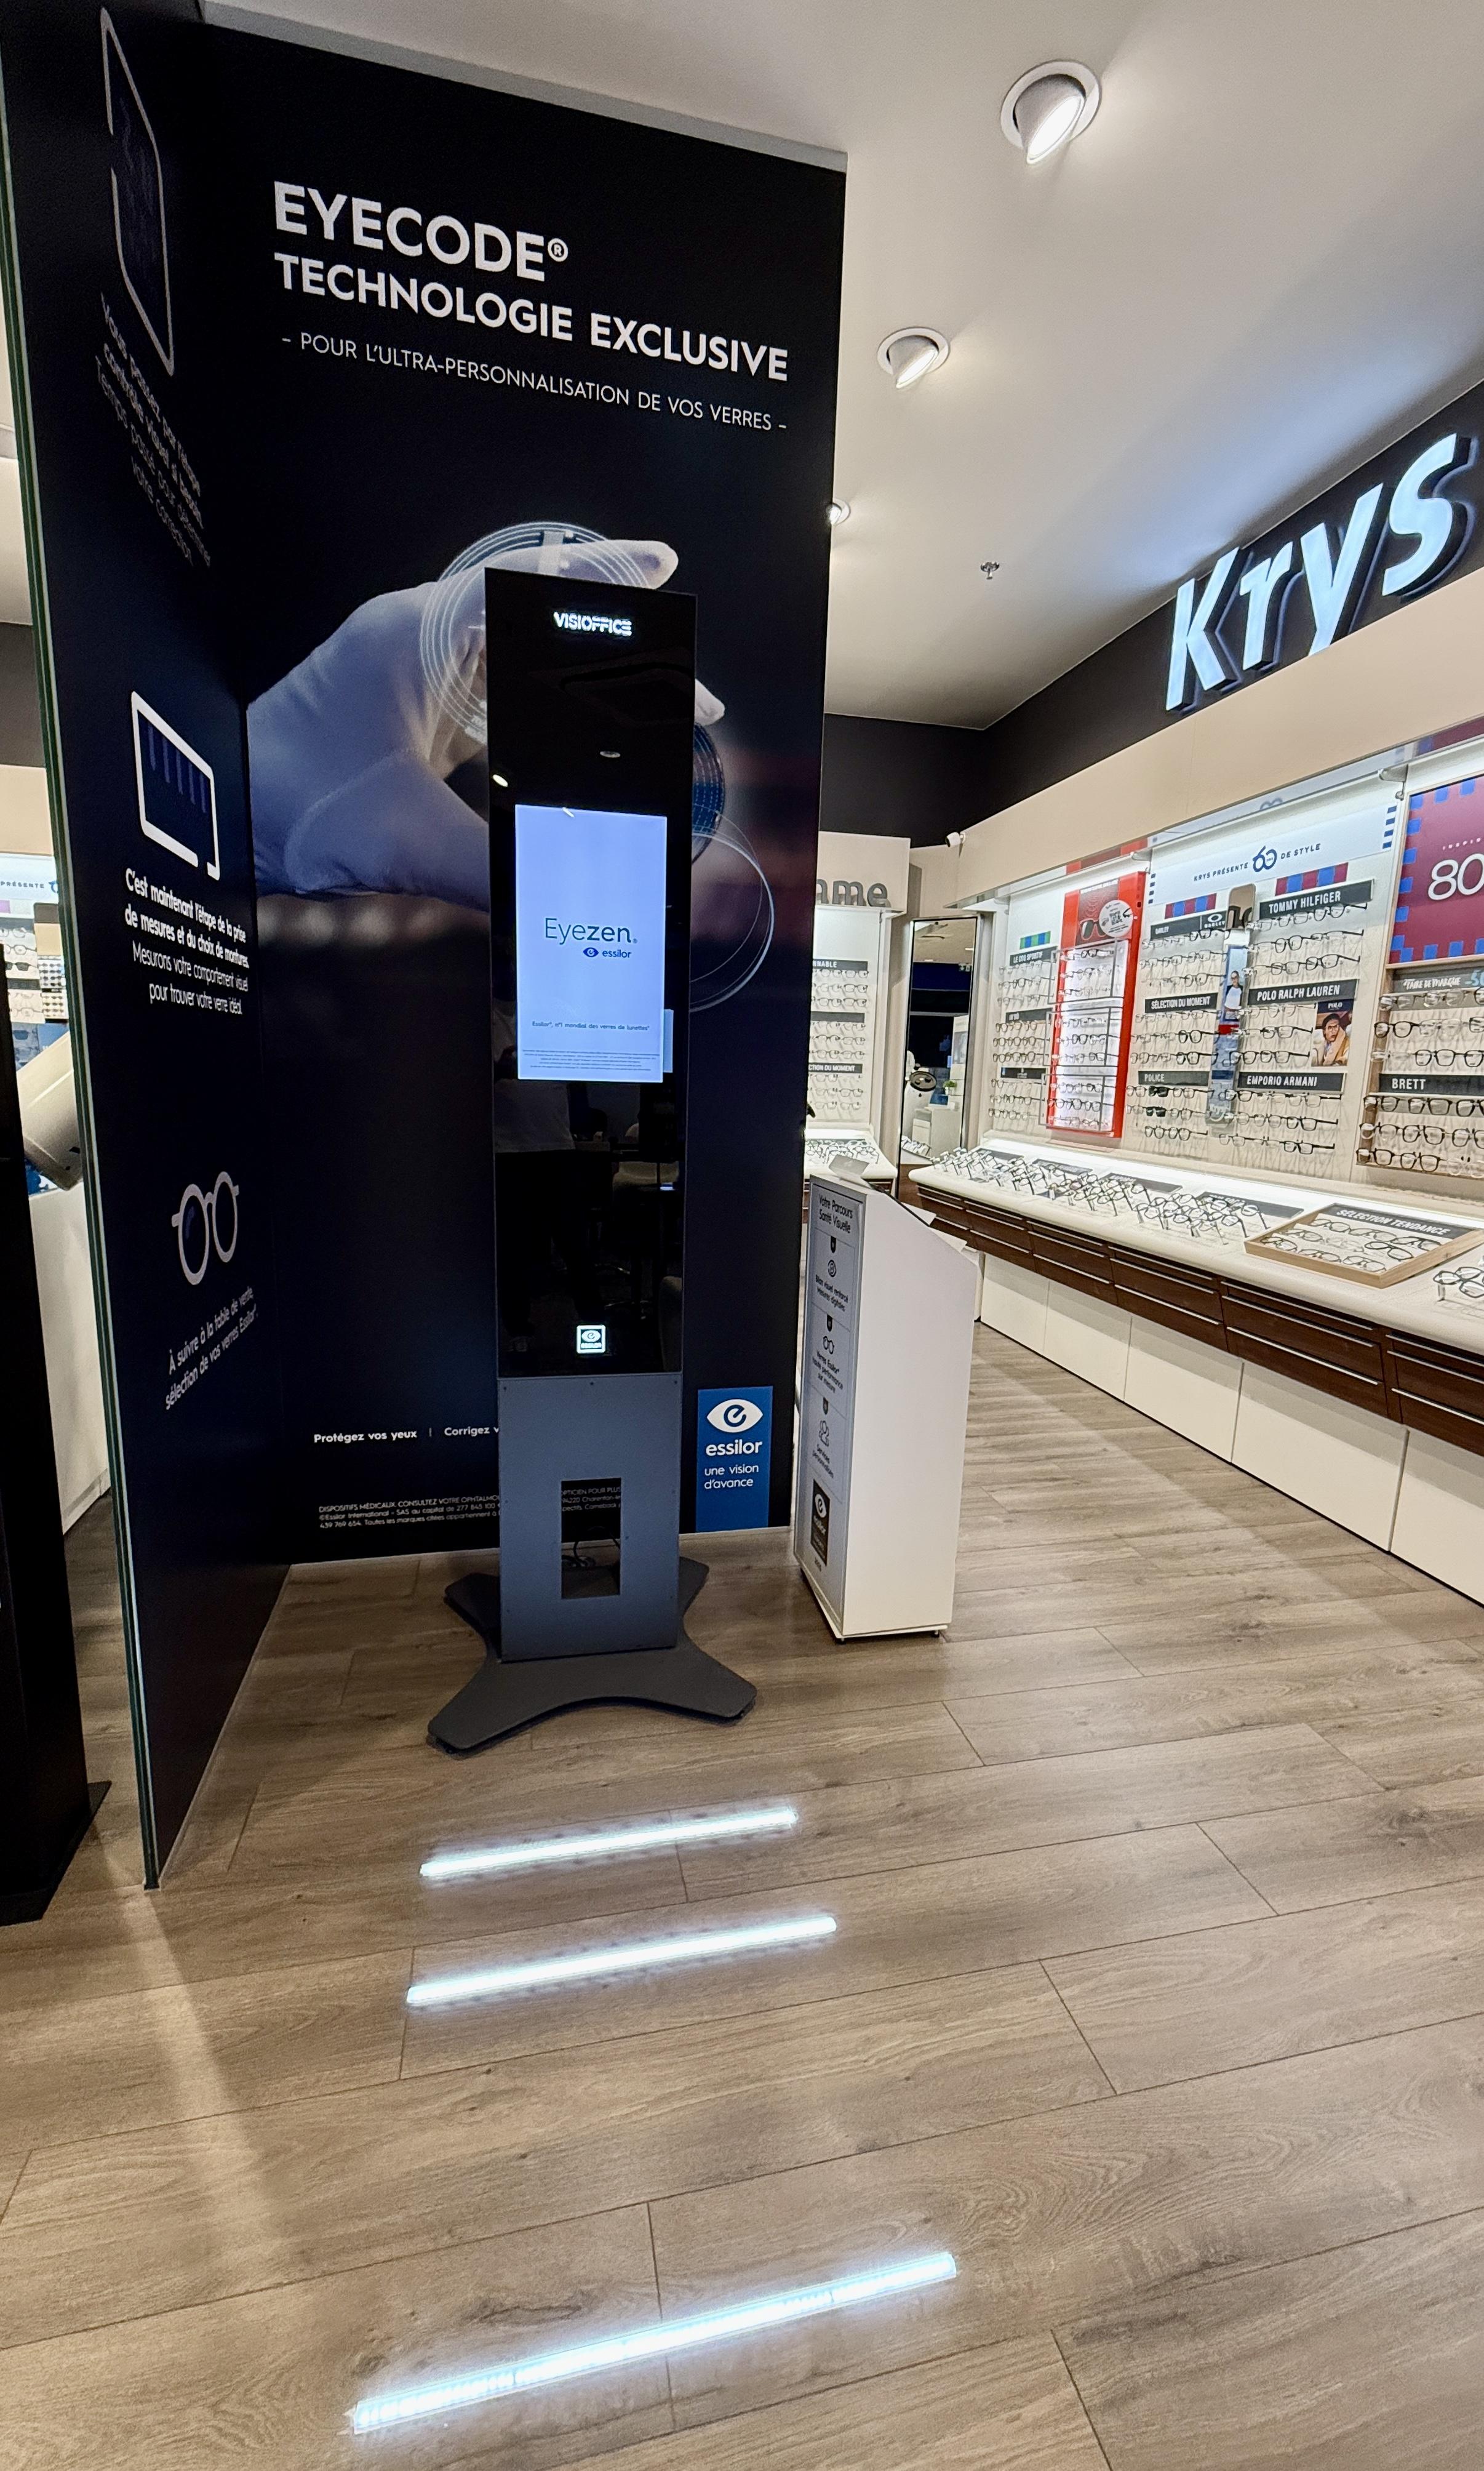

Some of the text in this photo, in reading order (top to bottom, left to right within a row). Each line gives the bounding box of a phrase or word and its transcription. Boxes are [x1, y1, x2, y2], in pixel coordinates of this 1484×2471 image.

[274, 181, 568, 282] EYECODE®
[101, 292, 127, 359] Vous
[274, 252, 788, 382] TECHNOLOGIE EXCLUSIVE
[300, 332, 772, 432] POUR L'ULTRA-PERSONNALISATION DE VOS VERRES
[1165, 433, 1458, 711] Krys
[553, 611, 632, 637] VISIOFFICE
[1194, 872, 1210, 882] KRYS
[1213, 862, 1249, 876] PRÉSENTE
[1281, 851, 1291, 860] DE
[1293, 843, 1321, 857] STYLE
[126, 868, 247, 943] C'est maintenant l'étape de la prise
[1269, 891, 1342, 914] TOMMY HILFIGER
[124, 903, 138, 928] de
[140, 915, 175, 942] mesures
[177, 926, 185, 945] et
[186, 929, 196, 950] du
[197, 936, 215, 956] choix
[215, 941, 224, 959] de
[132, 940, 249, 992] Mesurons votre comportement visuel
[602, 949, 632, 958] essilor
[149, 982, 169, 1004] pour
[170, 983, 195, 1006] trouver
[196, 990, 213, 1010] votre
[213, 997, 228, 1013] verre
[1151, 996, 1211, 1009] SÉLECTION DU MOMENT
[1257, 984, 1340, 1002] POLO RALPH LAUREN
[1144, 1073, 1165, 1083] POLICE
[1247, 1075, 1318, 1087] EMPORIO ARMANI
[1391, 1078, 1427, 1091] BRETT
[818, 1193, 853, 1219] Votre Parcours
[819, 1209, 852, 1234] Santé Visuelle
[1390, 1219, 1451, 1235] TENDANCE
[177, 1335, 199, 1368] suivre
[200, 1326, 206, 1344] à
[205, 1320, 214, 1338] la
[214, 1306, 231, 1332] table
[230, 1297, 239, 1316] de
[166, 1365, 199, 1411] sélection
[199, 1355, 209, 1375] de
[209, 1344, 221, 1364] vos
[221, 1328, 239, 1351] verres
[314, 1432, 365, 1444] Protégez
[368, 1432, 388, 1441] vos
[391, 1430, 418, 1441] yeux
[444, 1426, 490, 1438] Corrigez
[705, 1439, 764, 1457] essilor
[704, 1464, 760, 1476] une vision
[704, 1478, 754, 1491] d'avance
[397, 1498, 438, 1508] CONSULTEZ
